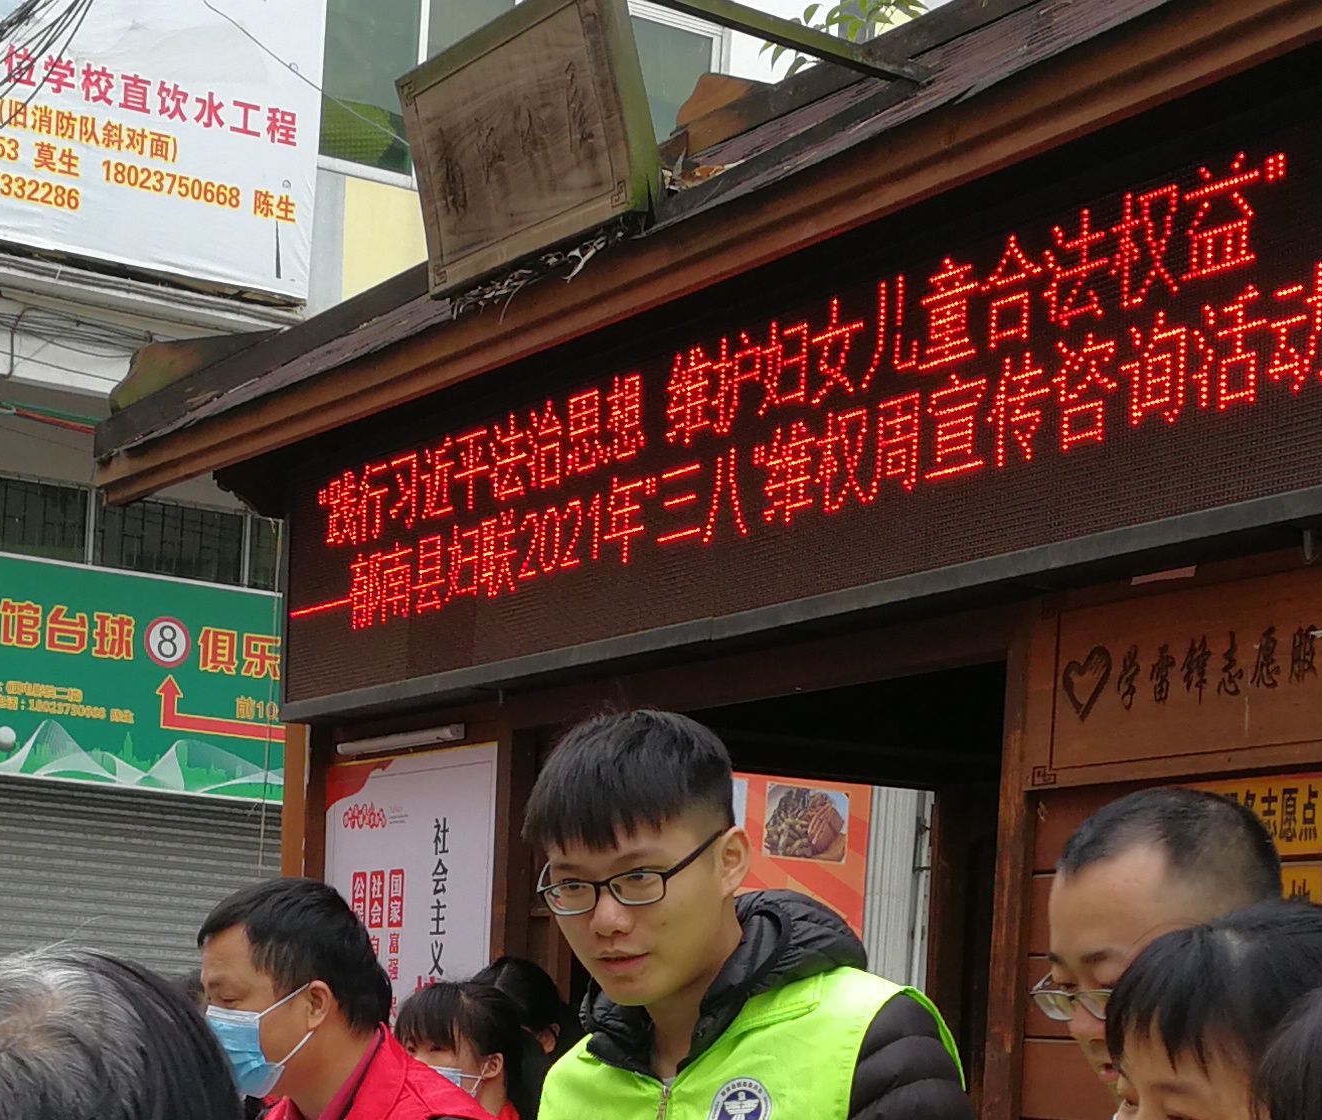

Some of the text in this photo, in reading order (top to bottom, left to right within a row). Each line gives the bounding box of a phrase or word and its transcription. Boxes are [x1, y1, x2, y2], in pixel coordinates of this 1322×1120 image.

[34, 142, 80, 177] 莫生
[101, 160, 240, 208] 18023750668
[252, 189, 296, 222] 陈生
[371, 874, 382, 924] 社会
[428, 817, 450, 976] 社会主义
